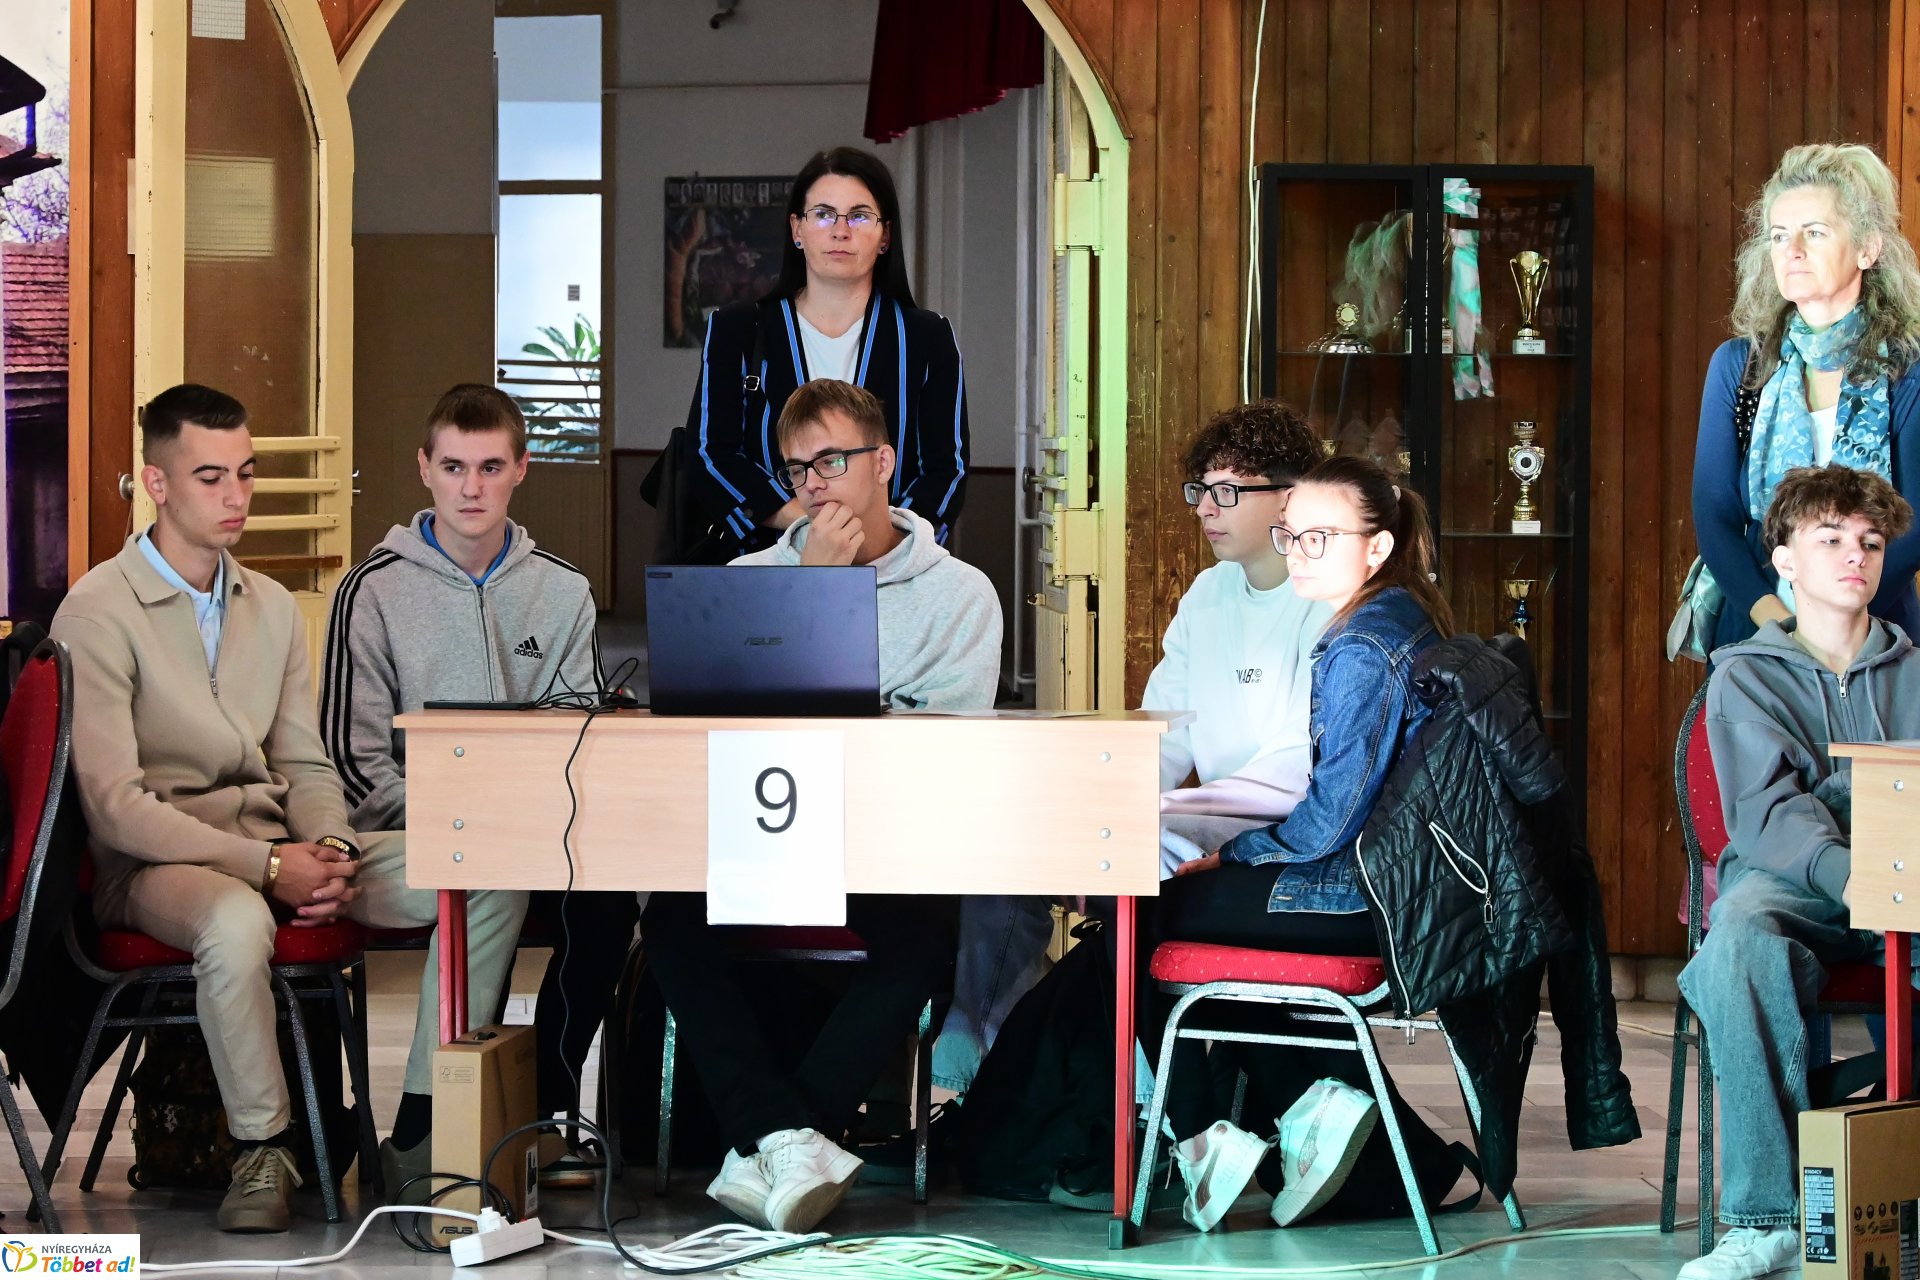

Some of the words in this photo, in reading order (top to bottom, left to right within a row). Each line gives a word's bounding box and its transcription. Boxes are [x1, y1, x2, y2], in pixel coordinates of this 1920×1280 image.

[744, 637, 783, 646] ASUS
[514, 647, 544, 660] adidas
[755, 767, 797, 834] 9
[439, 1226, 473, 1235] ASUS
